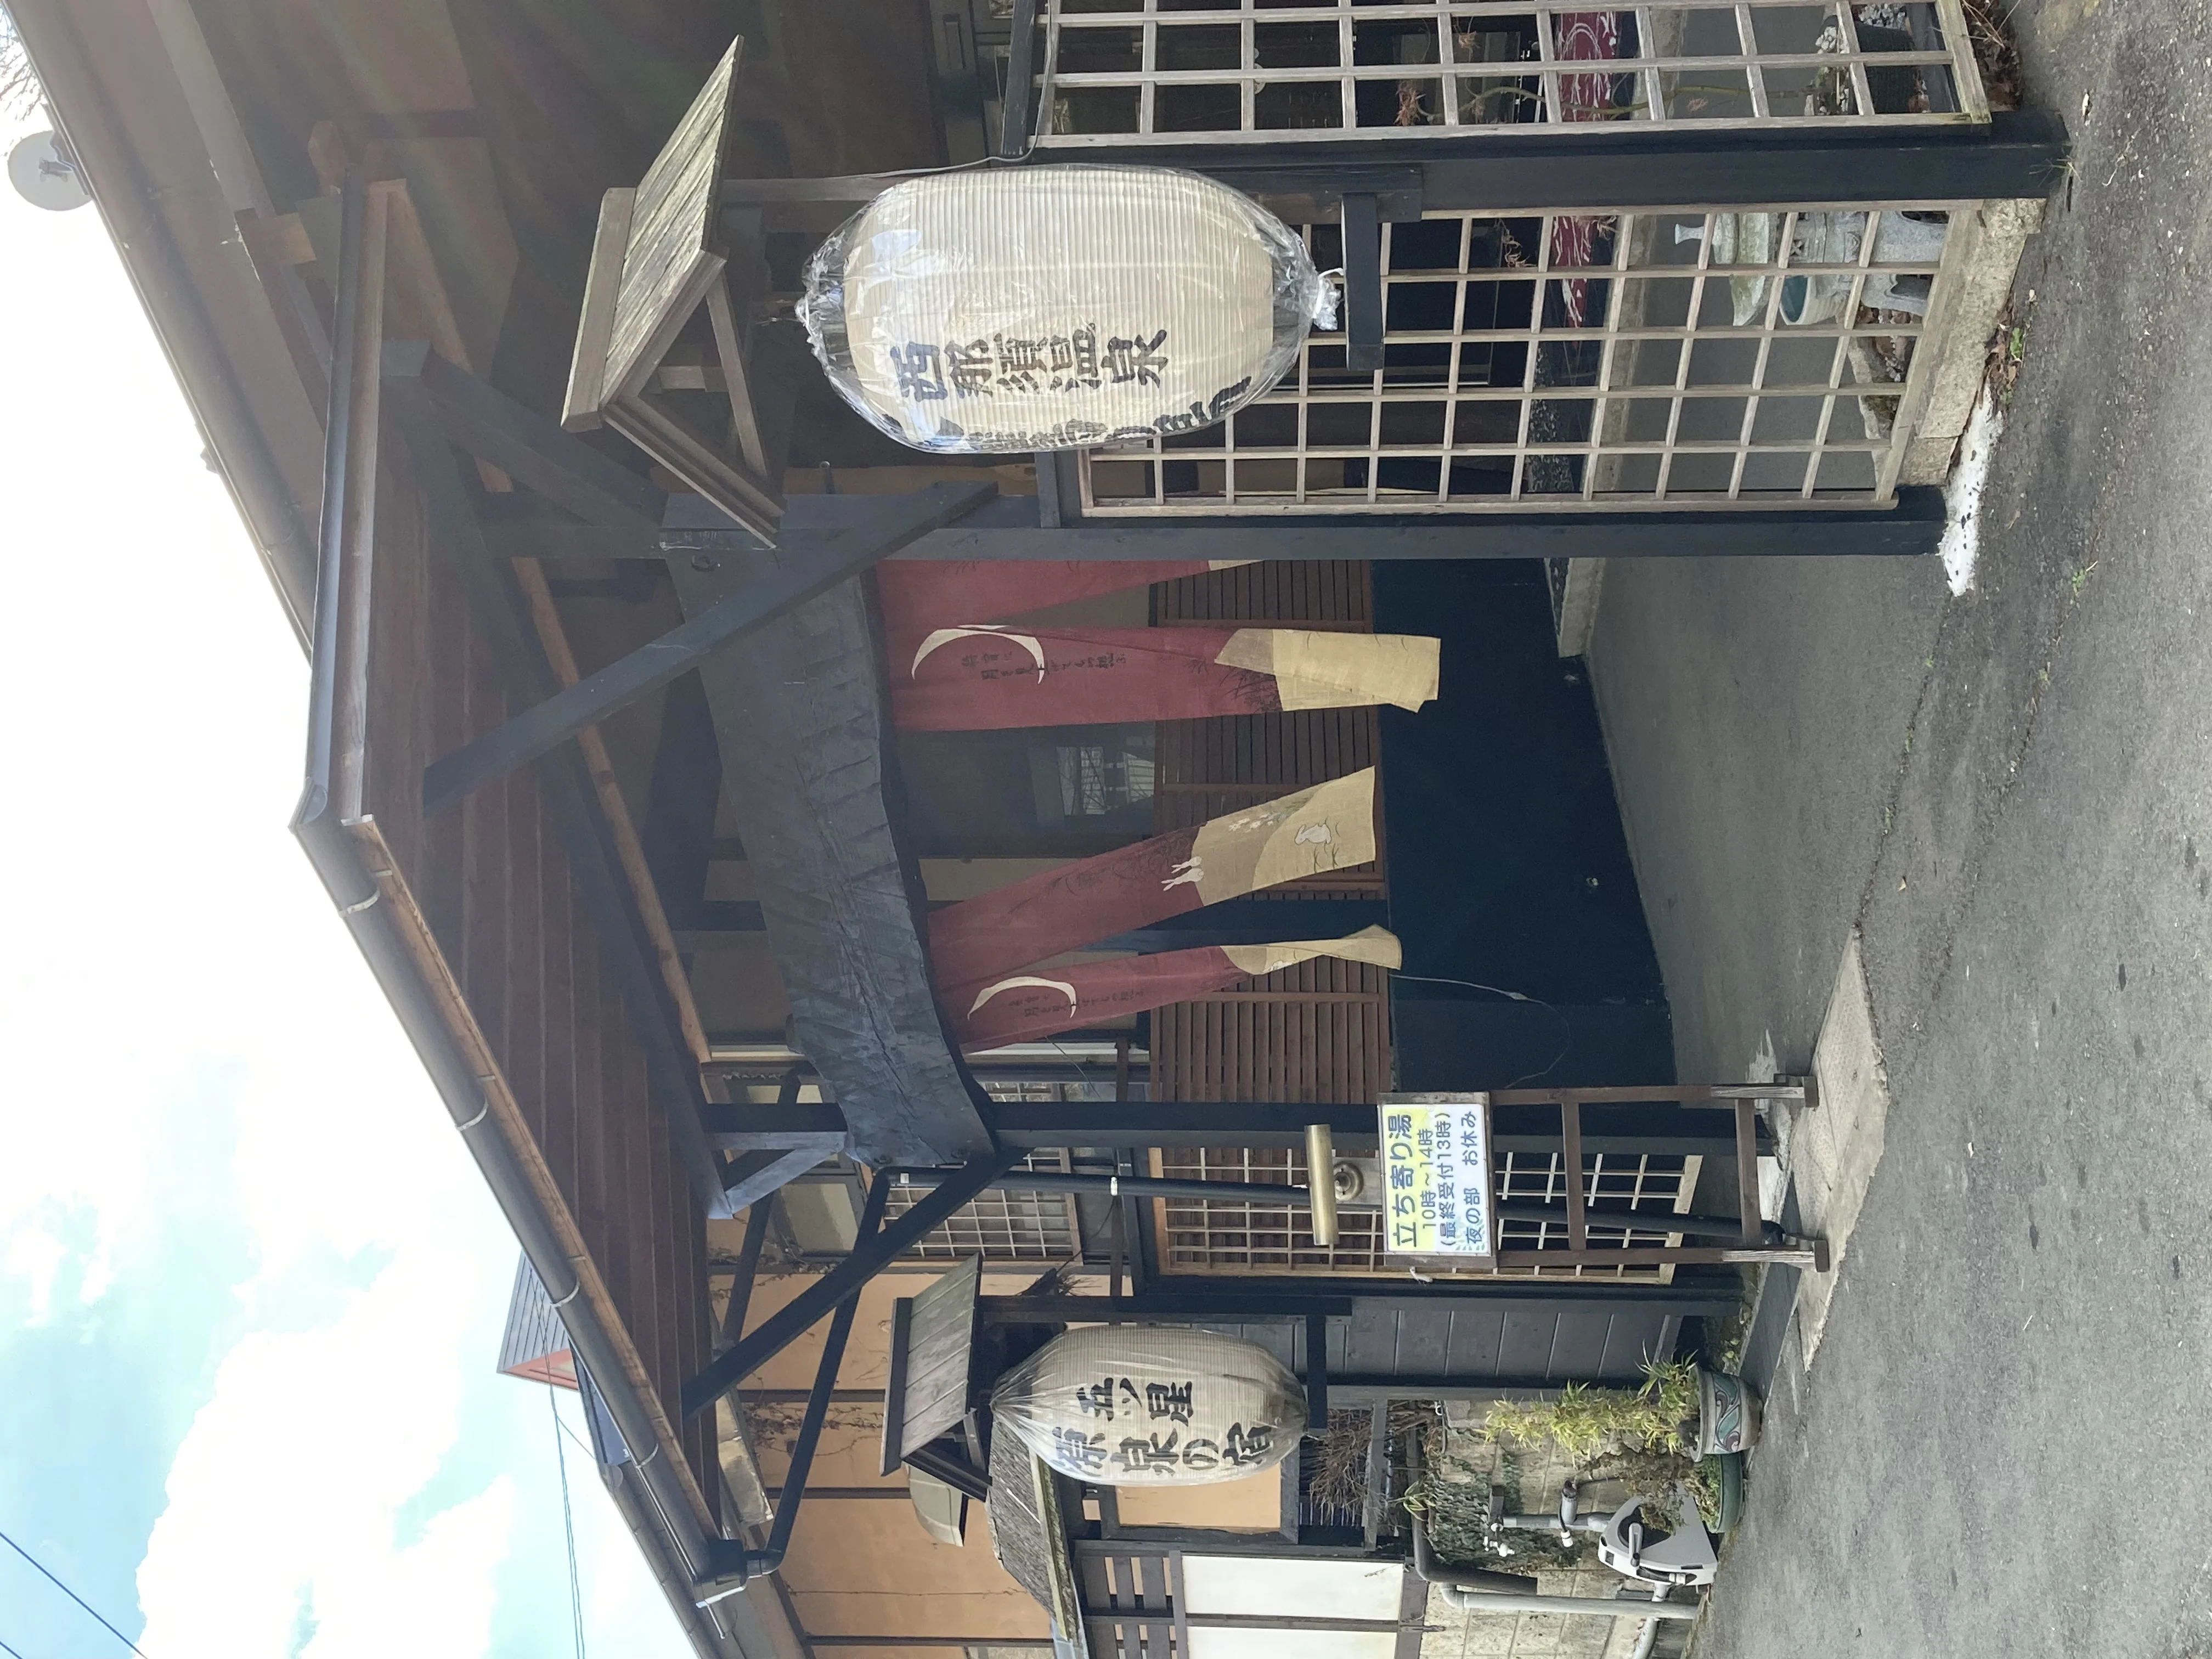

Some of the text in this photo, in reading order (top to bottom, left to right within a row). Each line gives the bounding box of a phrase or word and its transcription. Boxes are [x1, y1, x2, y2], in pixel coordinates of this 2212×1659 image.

[890, 323, 1168, 402] 西那須温泉
[1387, 1114, 1417, 1248] 立ち寄り湯
[1434, 1113, 1456, 1246] (最終受付13時)
[1460, 1111, 1482, 1244] 夜の部 お休み
[1052, 1422, 1275, 1476] 源泉の宿
[1076, 1377, 1194, 1427] 五ツ星
